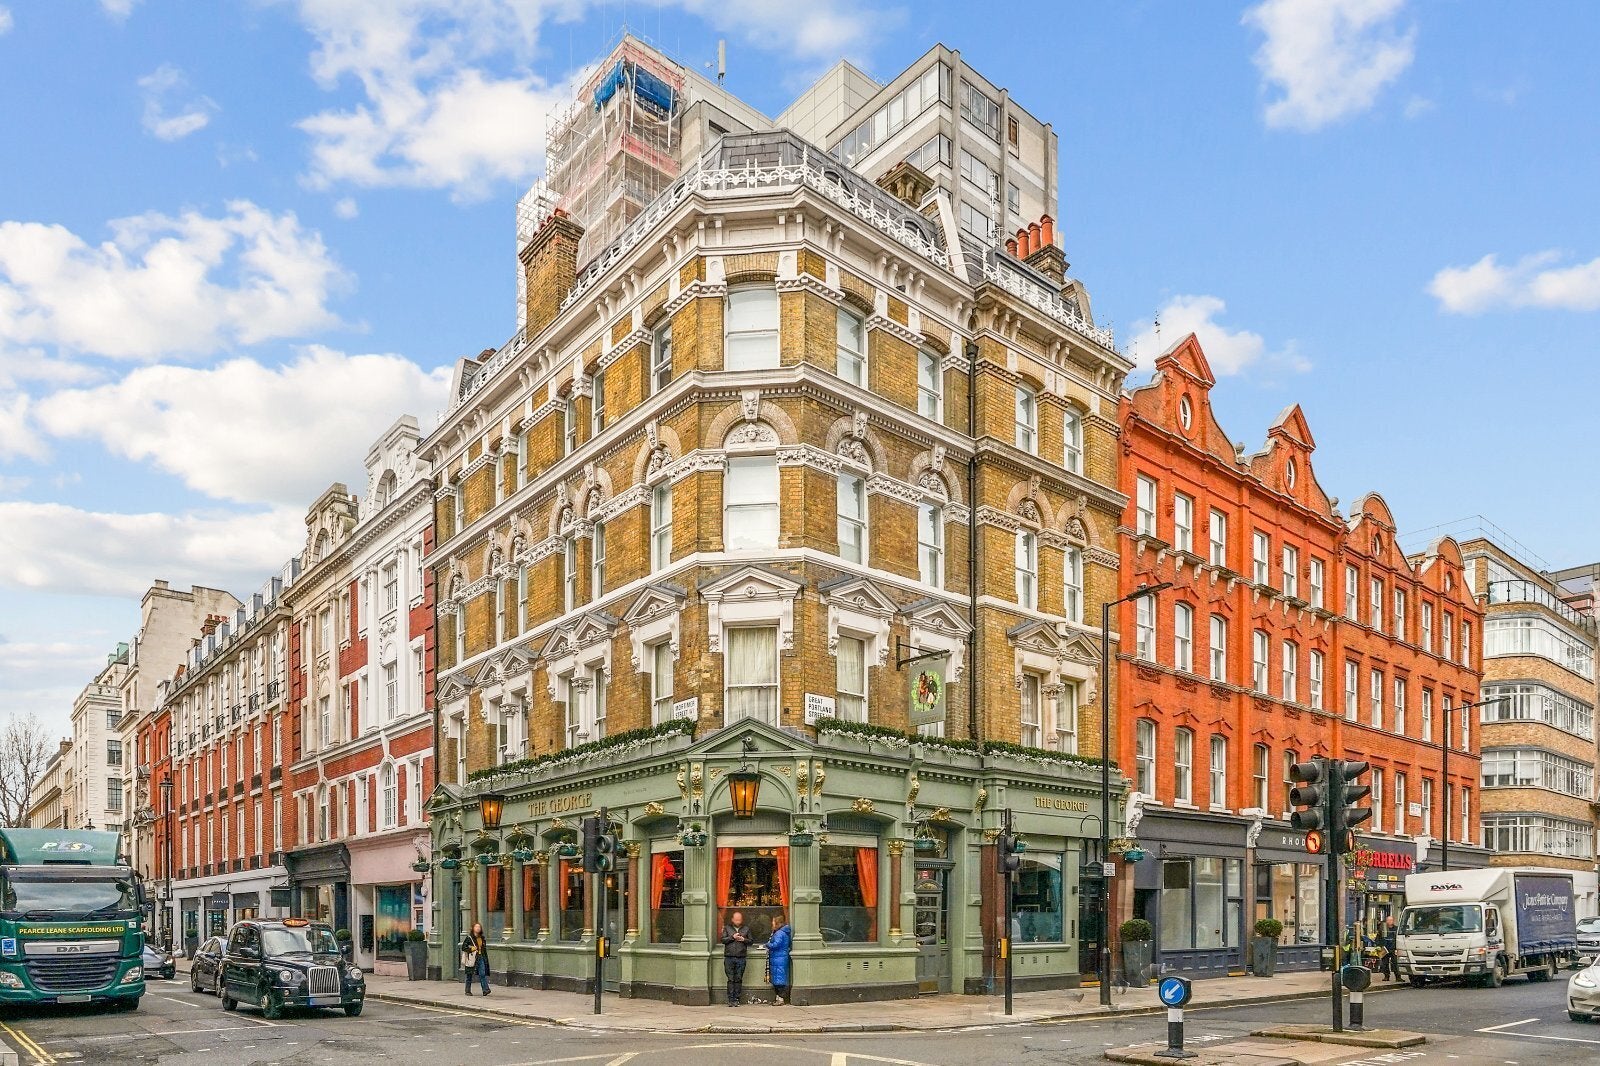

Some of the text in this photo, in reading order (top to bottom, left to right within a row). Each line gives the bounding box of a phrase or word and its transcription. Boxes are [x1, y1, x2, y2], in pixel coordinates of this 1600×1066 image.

[808, 695, 823, 704] GREAT
[675, 700, 695, 711] MORTIMER
[808, 703, 833, 714] PORTLAND
[675, 709, 688, 719] STREET
[528, 793, 592, 817] THE GEORGE
[1035, 796, 1089, 812] THE GEORGE
[1282, 836, 1306, 846] RHOD
[56, 945, 90, 953] DAF
